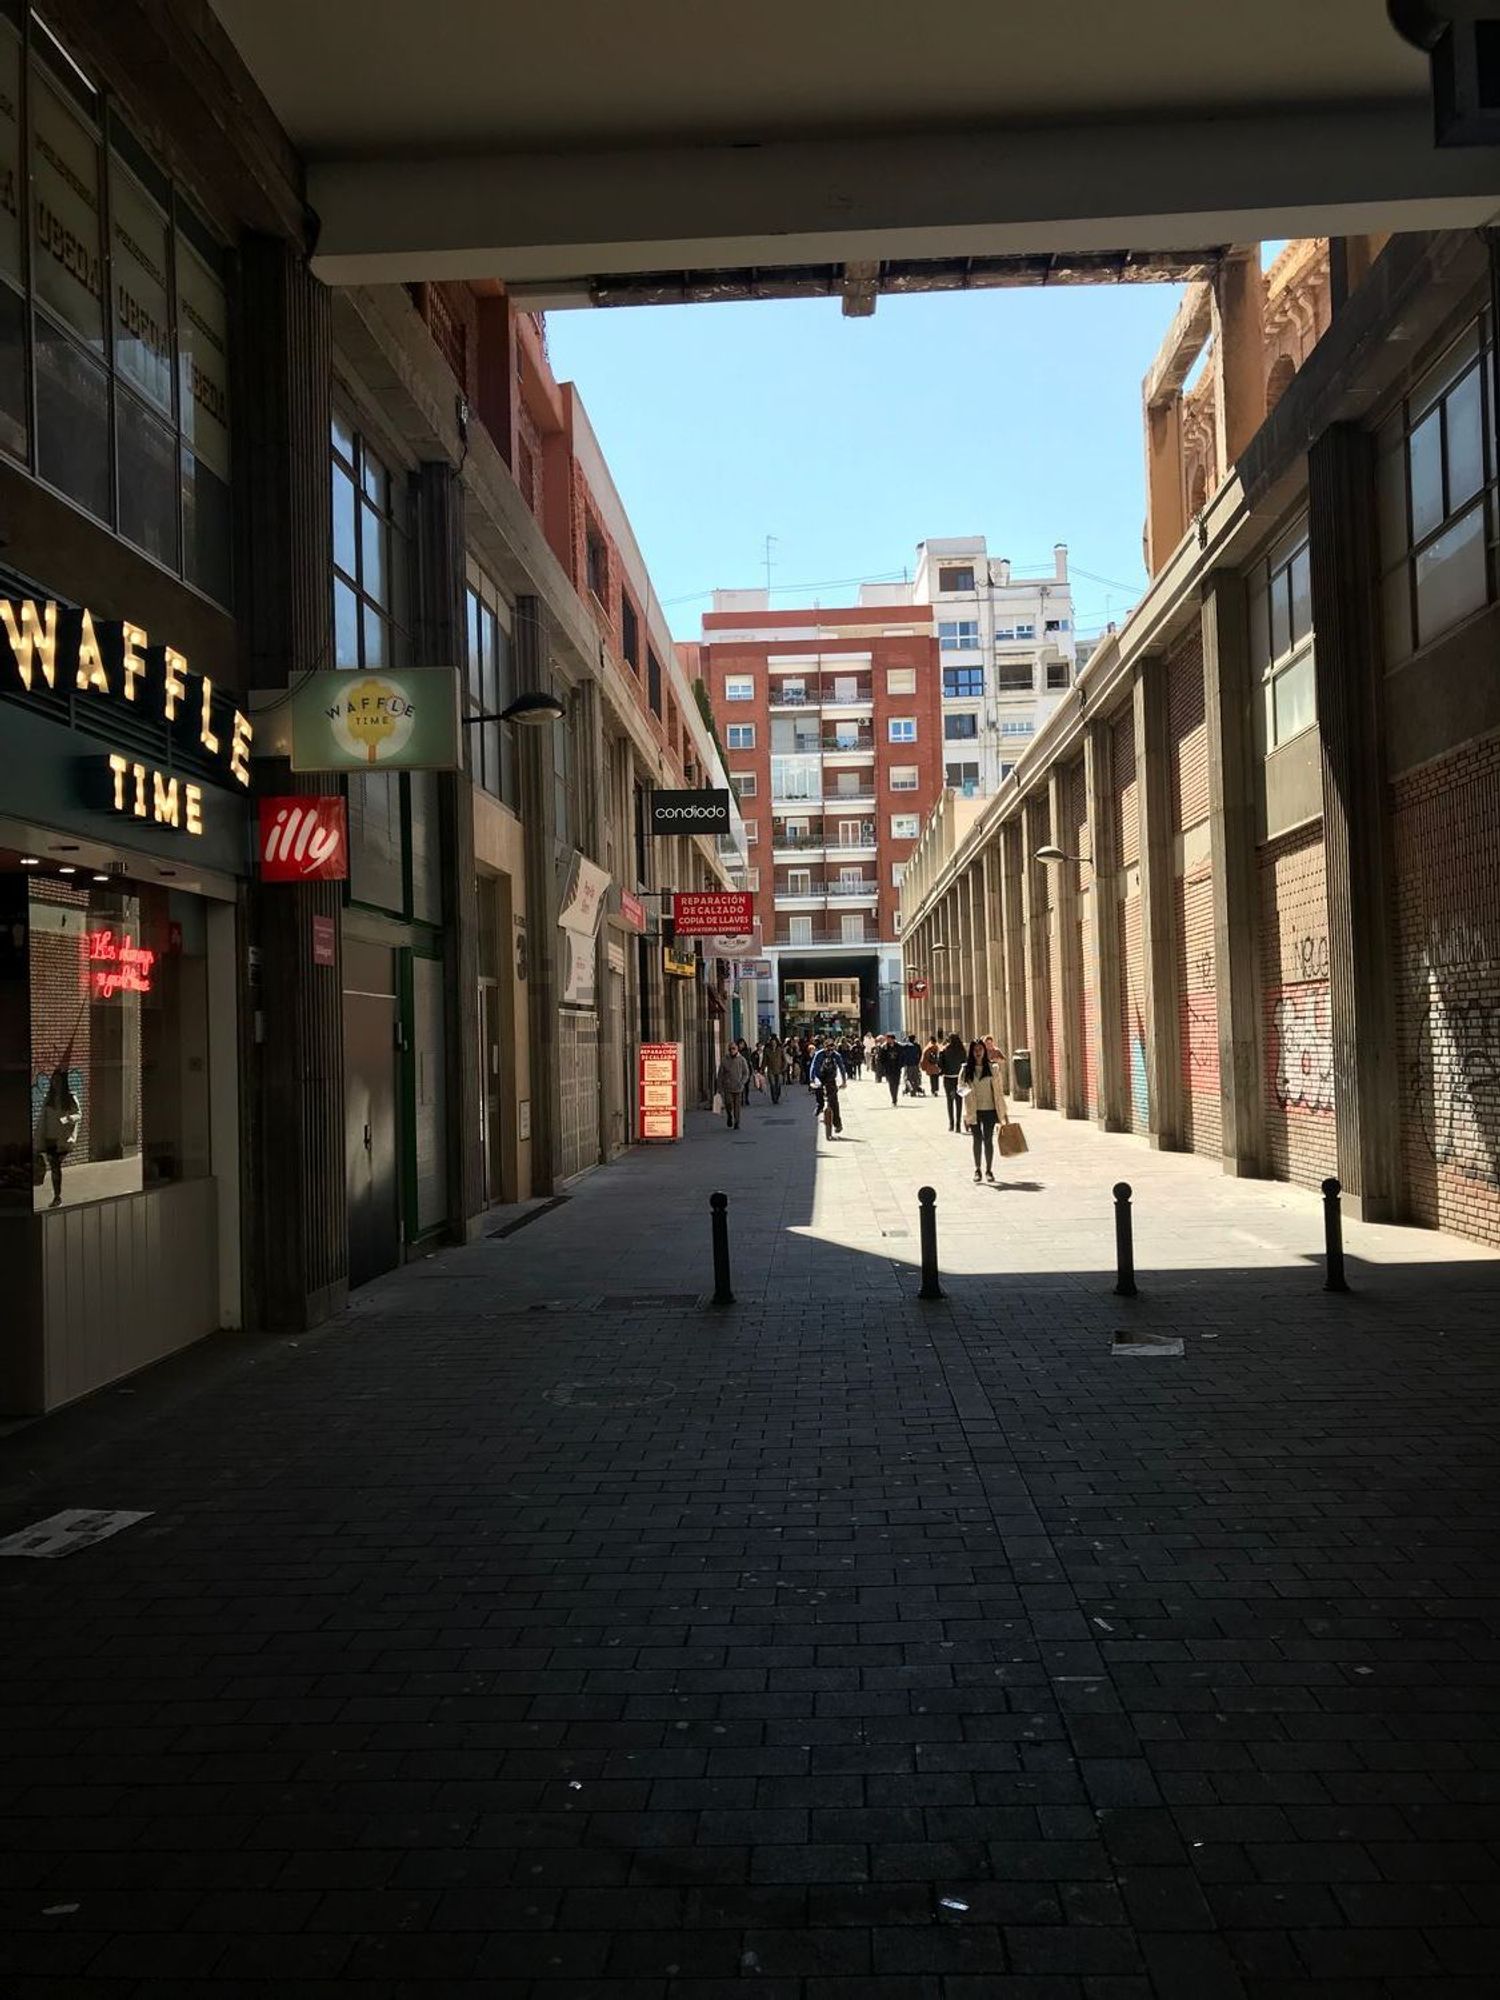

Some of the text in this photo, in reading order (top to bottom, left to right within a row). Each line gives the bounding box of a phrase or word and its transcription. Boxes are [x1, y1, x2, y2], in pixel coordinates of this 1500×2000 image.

[0, 598, 254, 789] WAFFLE
[324, 695, 417, 722] WAFFLE
[355, 715, 390, 726] TIME
[107, 753, 204, 836] TIME
[264, 806, 340, 874] illy
[681, 894, 746, 906] REPARACIÓN
[678, 915, 749, 925] COPIA DE LLAVES
[683, 906, 744, 915] DE CALZADO
